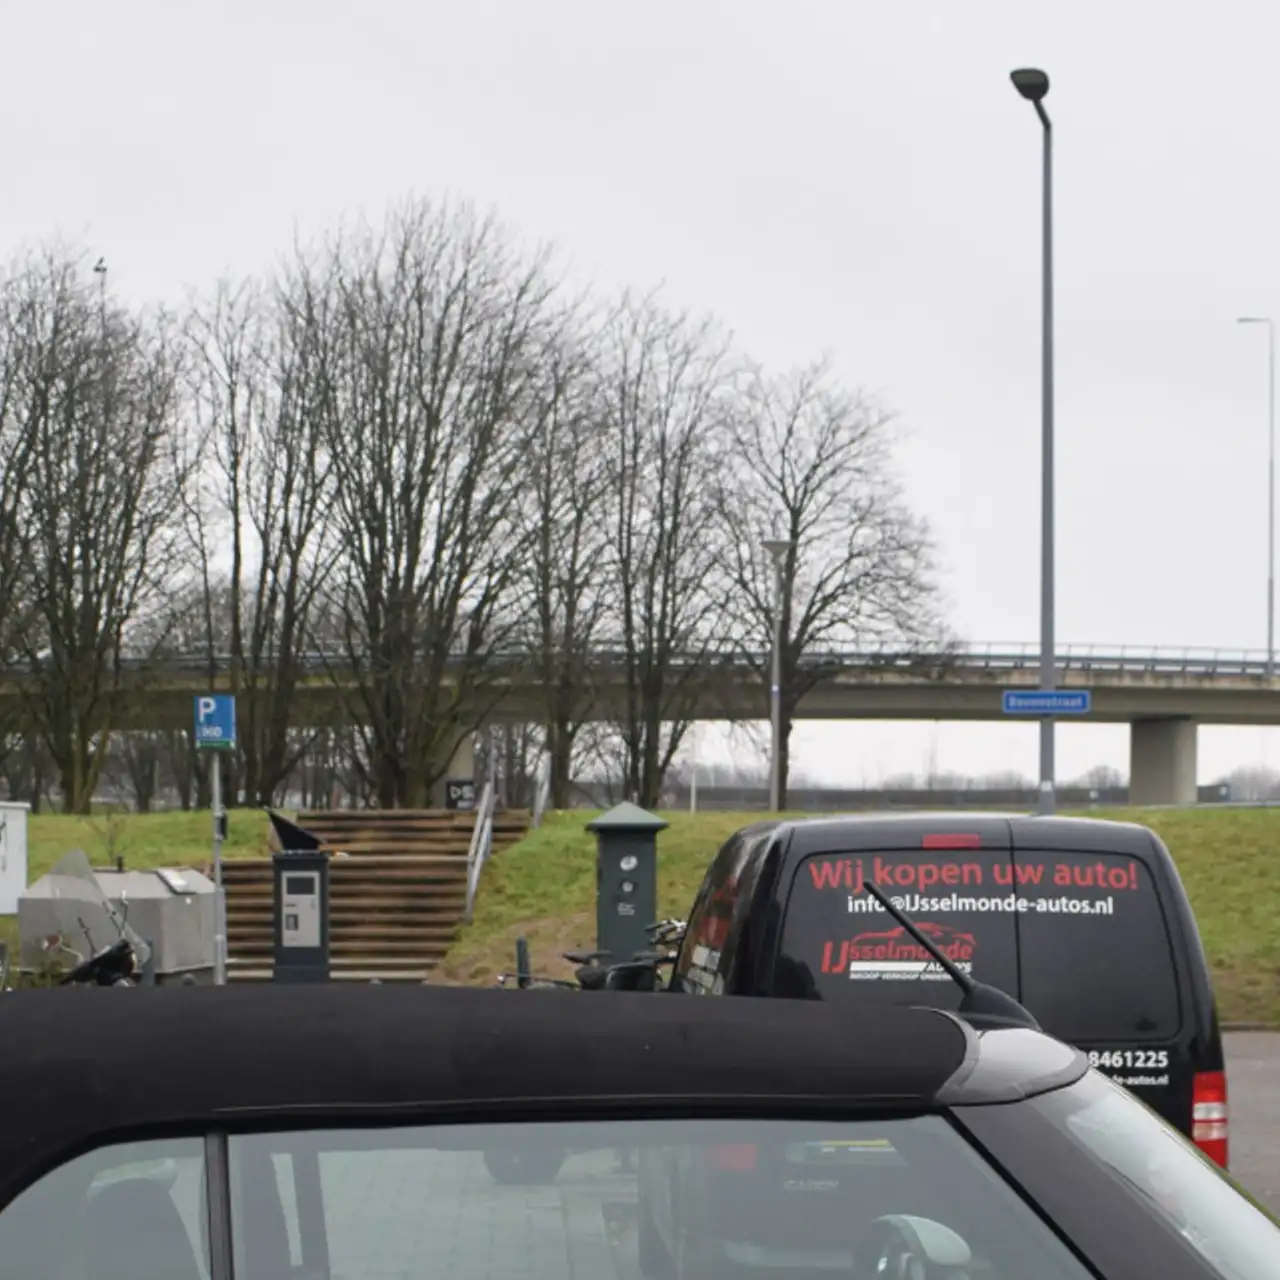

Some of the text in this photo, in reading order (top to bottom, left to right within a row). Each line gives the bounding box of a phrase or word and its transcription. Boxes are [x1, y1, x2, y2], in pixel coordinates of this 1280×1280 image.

[199, 697, 217, 723] P
[809, 858, 1138, 895] Wij kopen uw auto!
